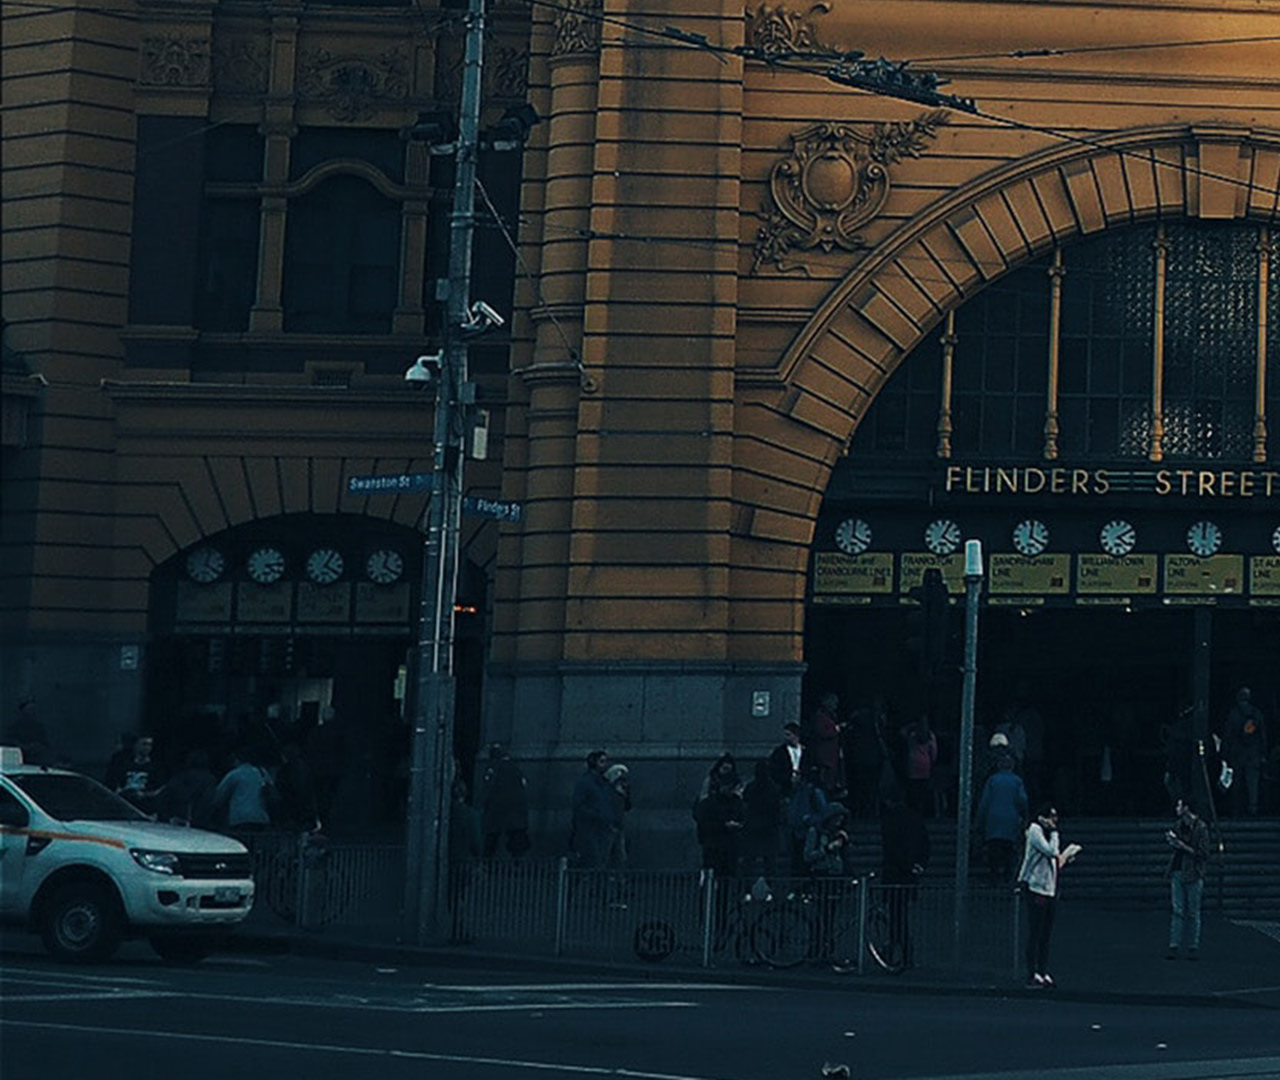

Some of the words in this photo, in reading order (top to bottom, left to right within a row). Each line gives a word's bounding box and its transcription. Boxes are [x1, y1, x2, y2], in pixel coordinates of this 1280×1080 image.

[350, 476, 398, 491] Swanston
[399, 475, 411, 488] St
[945, 466, 1110, 495] FLINDERS
[1155, 469, 1279, 497] STREET
